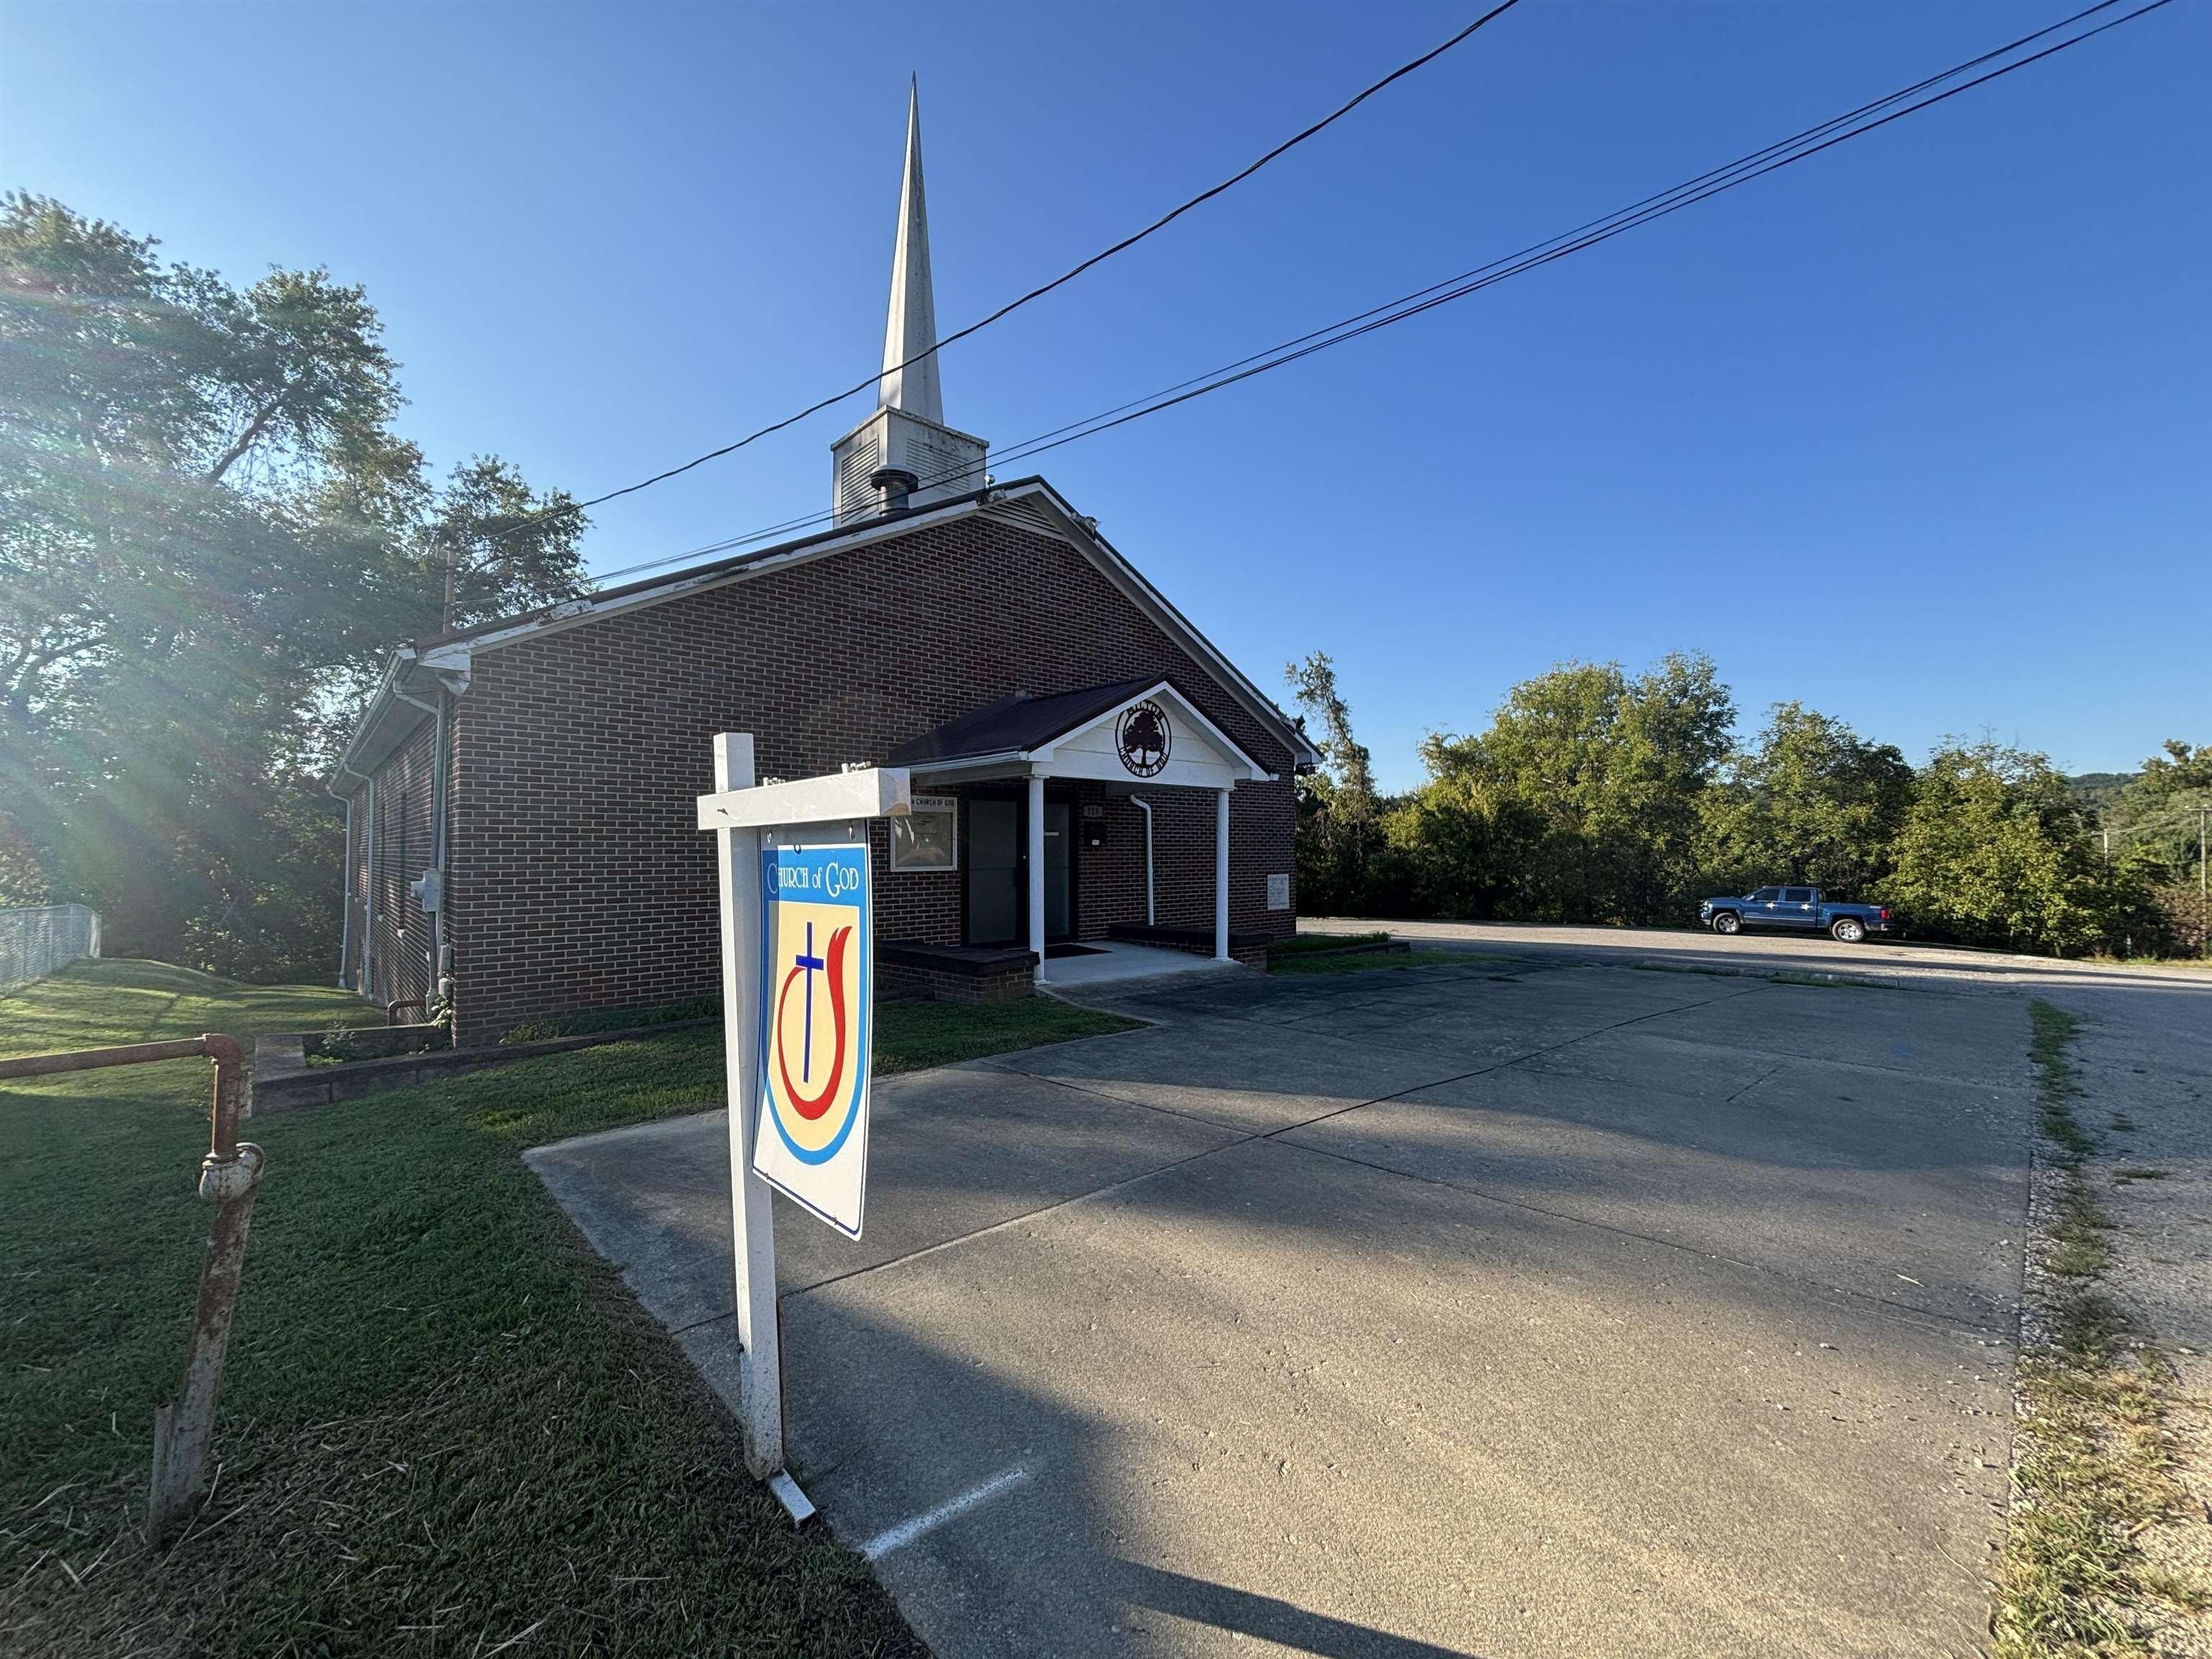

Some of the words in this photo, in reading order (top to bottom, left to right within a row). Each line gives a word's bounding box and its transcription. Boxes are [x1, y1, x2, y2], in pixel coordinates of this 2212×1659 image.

[1126, 701, 1164, 720] MILTON
[1118, 747, 1143, 776] CHURCH
[1155, 751, 1168, 770] GOD
[811, 867, 823, 889] of
